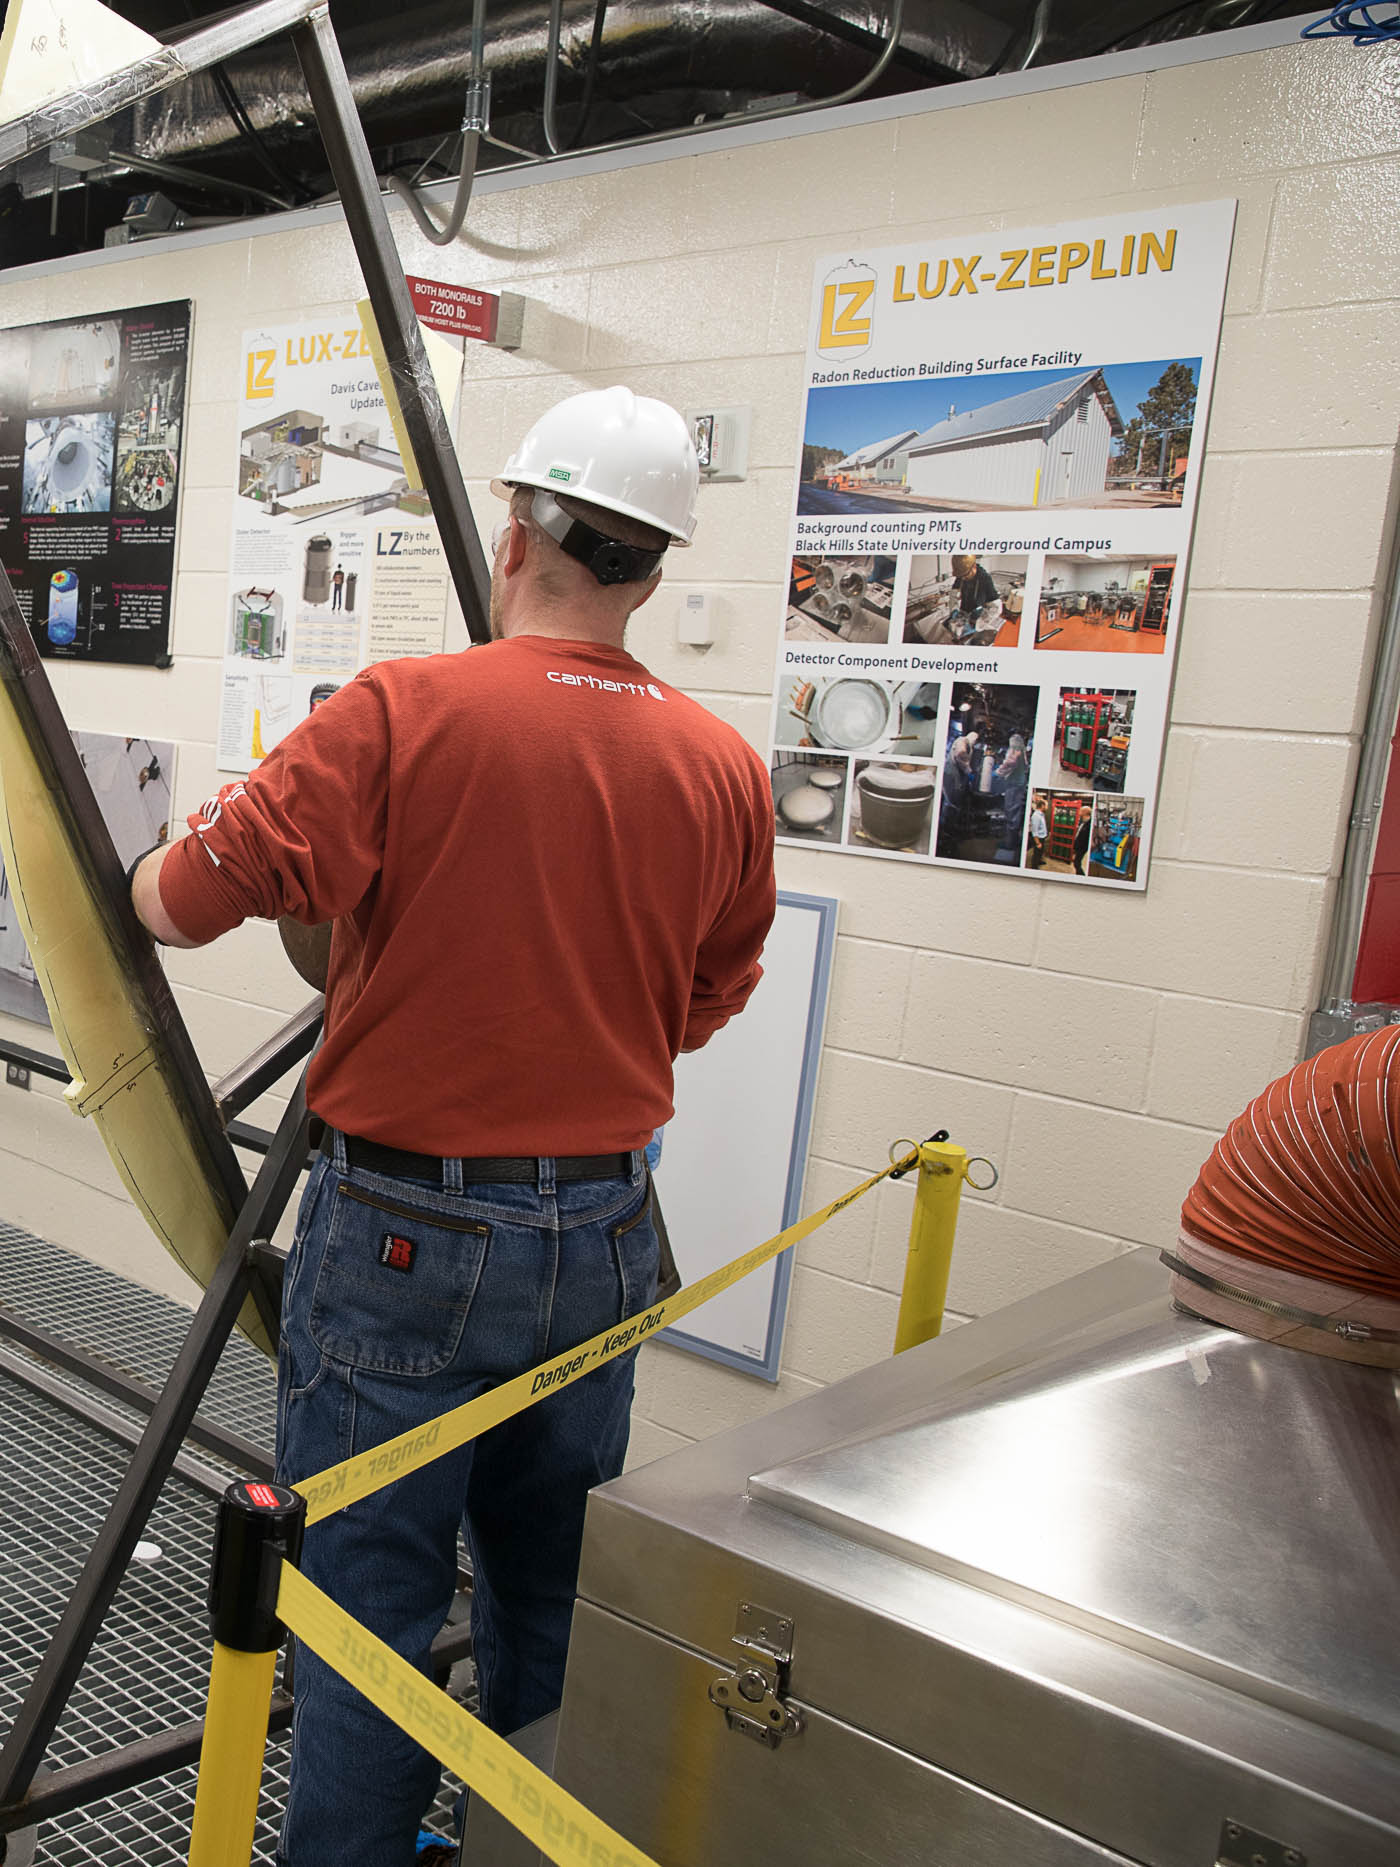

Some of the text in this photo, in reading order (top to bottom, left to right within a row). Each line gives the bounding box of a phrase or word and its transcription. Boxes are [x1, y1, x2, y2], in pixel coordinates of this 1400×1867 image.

[892, 229, 1178, 302] LUX-ZEPLIN
[415, 283, 483, 306] BOTH MONORAILS
[430, 300, 467, 319] 7200 lb
[818, 279, 875, 350] LZ
[812, 350, 1082, 384] Radon Reduction Building Surface Facility
[331, 381, 380, 395] Davis Cave
[351, 397, 387, 412] Update
[403, 531, 431, 543] By the
[797, 519, 962, 537] Background counting PMTs
[377, 532, 403, 556] LZ
[403, 547, 440, 556] numbers
[795, 537, 1112, 554] Black Hills State University Underground Campus
[785, 652, 999, 674] Detector Component Development
[546, 671, 645, 697] carhartt
[531, 1352, 590, 1396] Danger
[600, 1325, 638, 1357] Keep
[638, 1306, 665, 1334] Out
